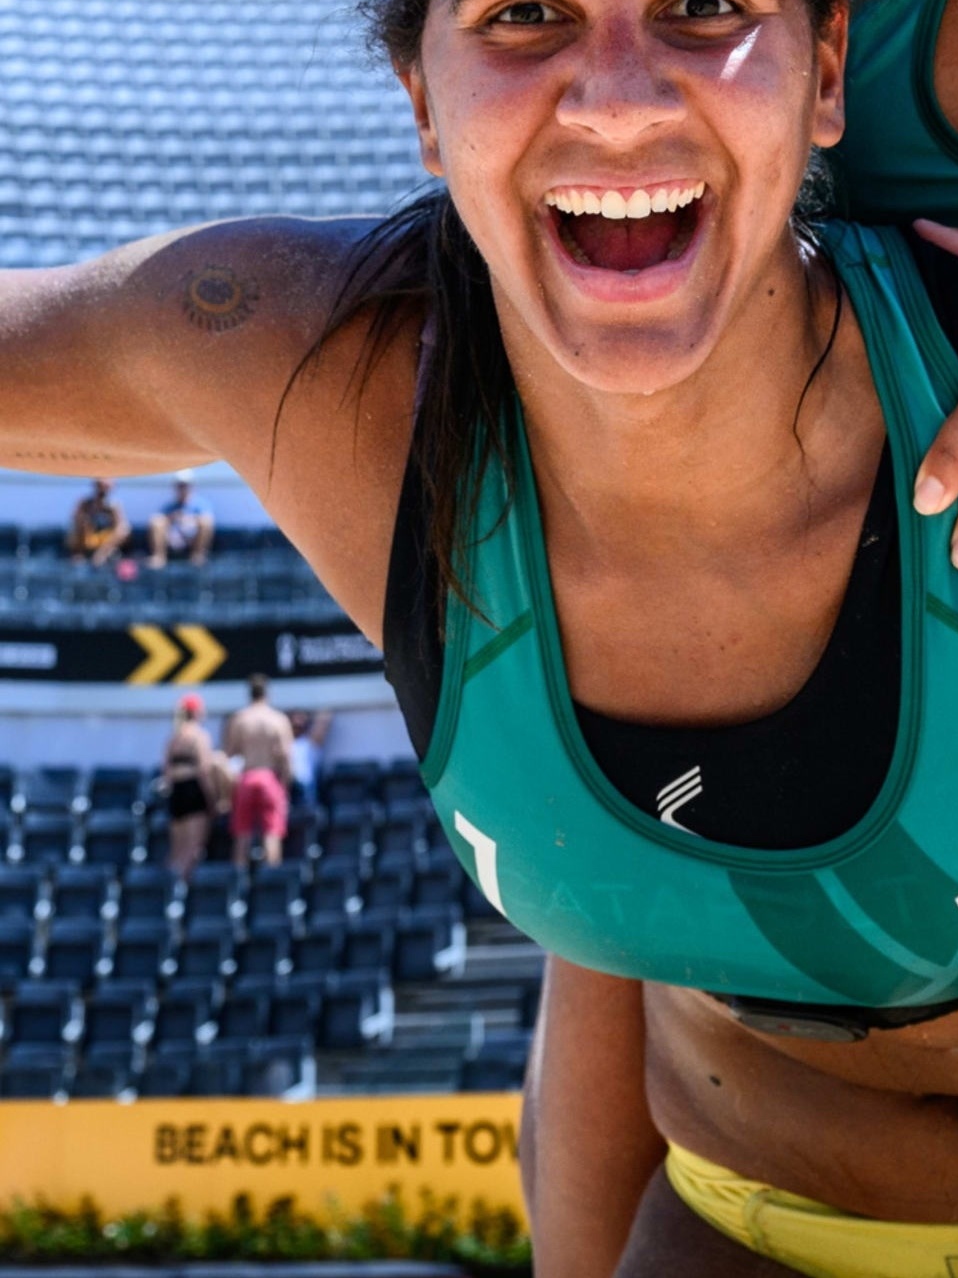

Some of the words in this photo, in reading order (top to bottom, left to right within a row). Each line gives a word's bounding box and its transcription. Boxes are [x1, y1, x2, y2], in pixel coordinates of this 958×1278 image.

[155, 1123, 310, 1165] BEACH
[322, 1123, 364, 1165] IS
[377, 1123, 421, 1163] IN
